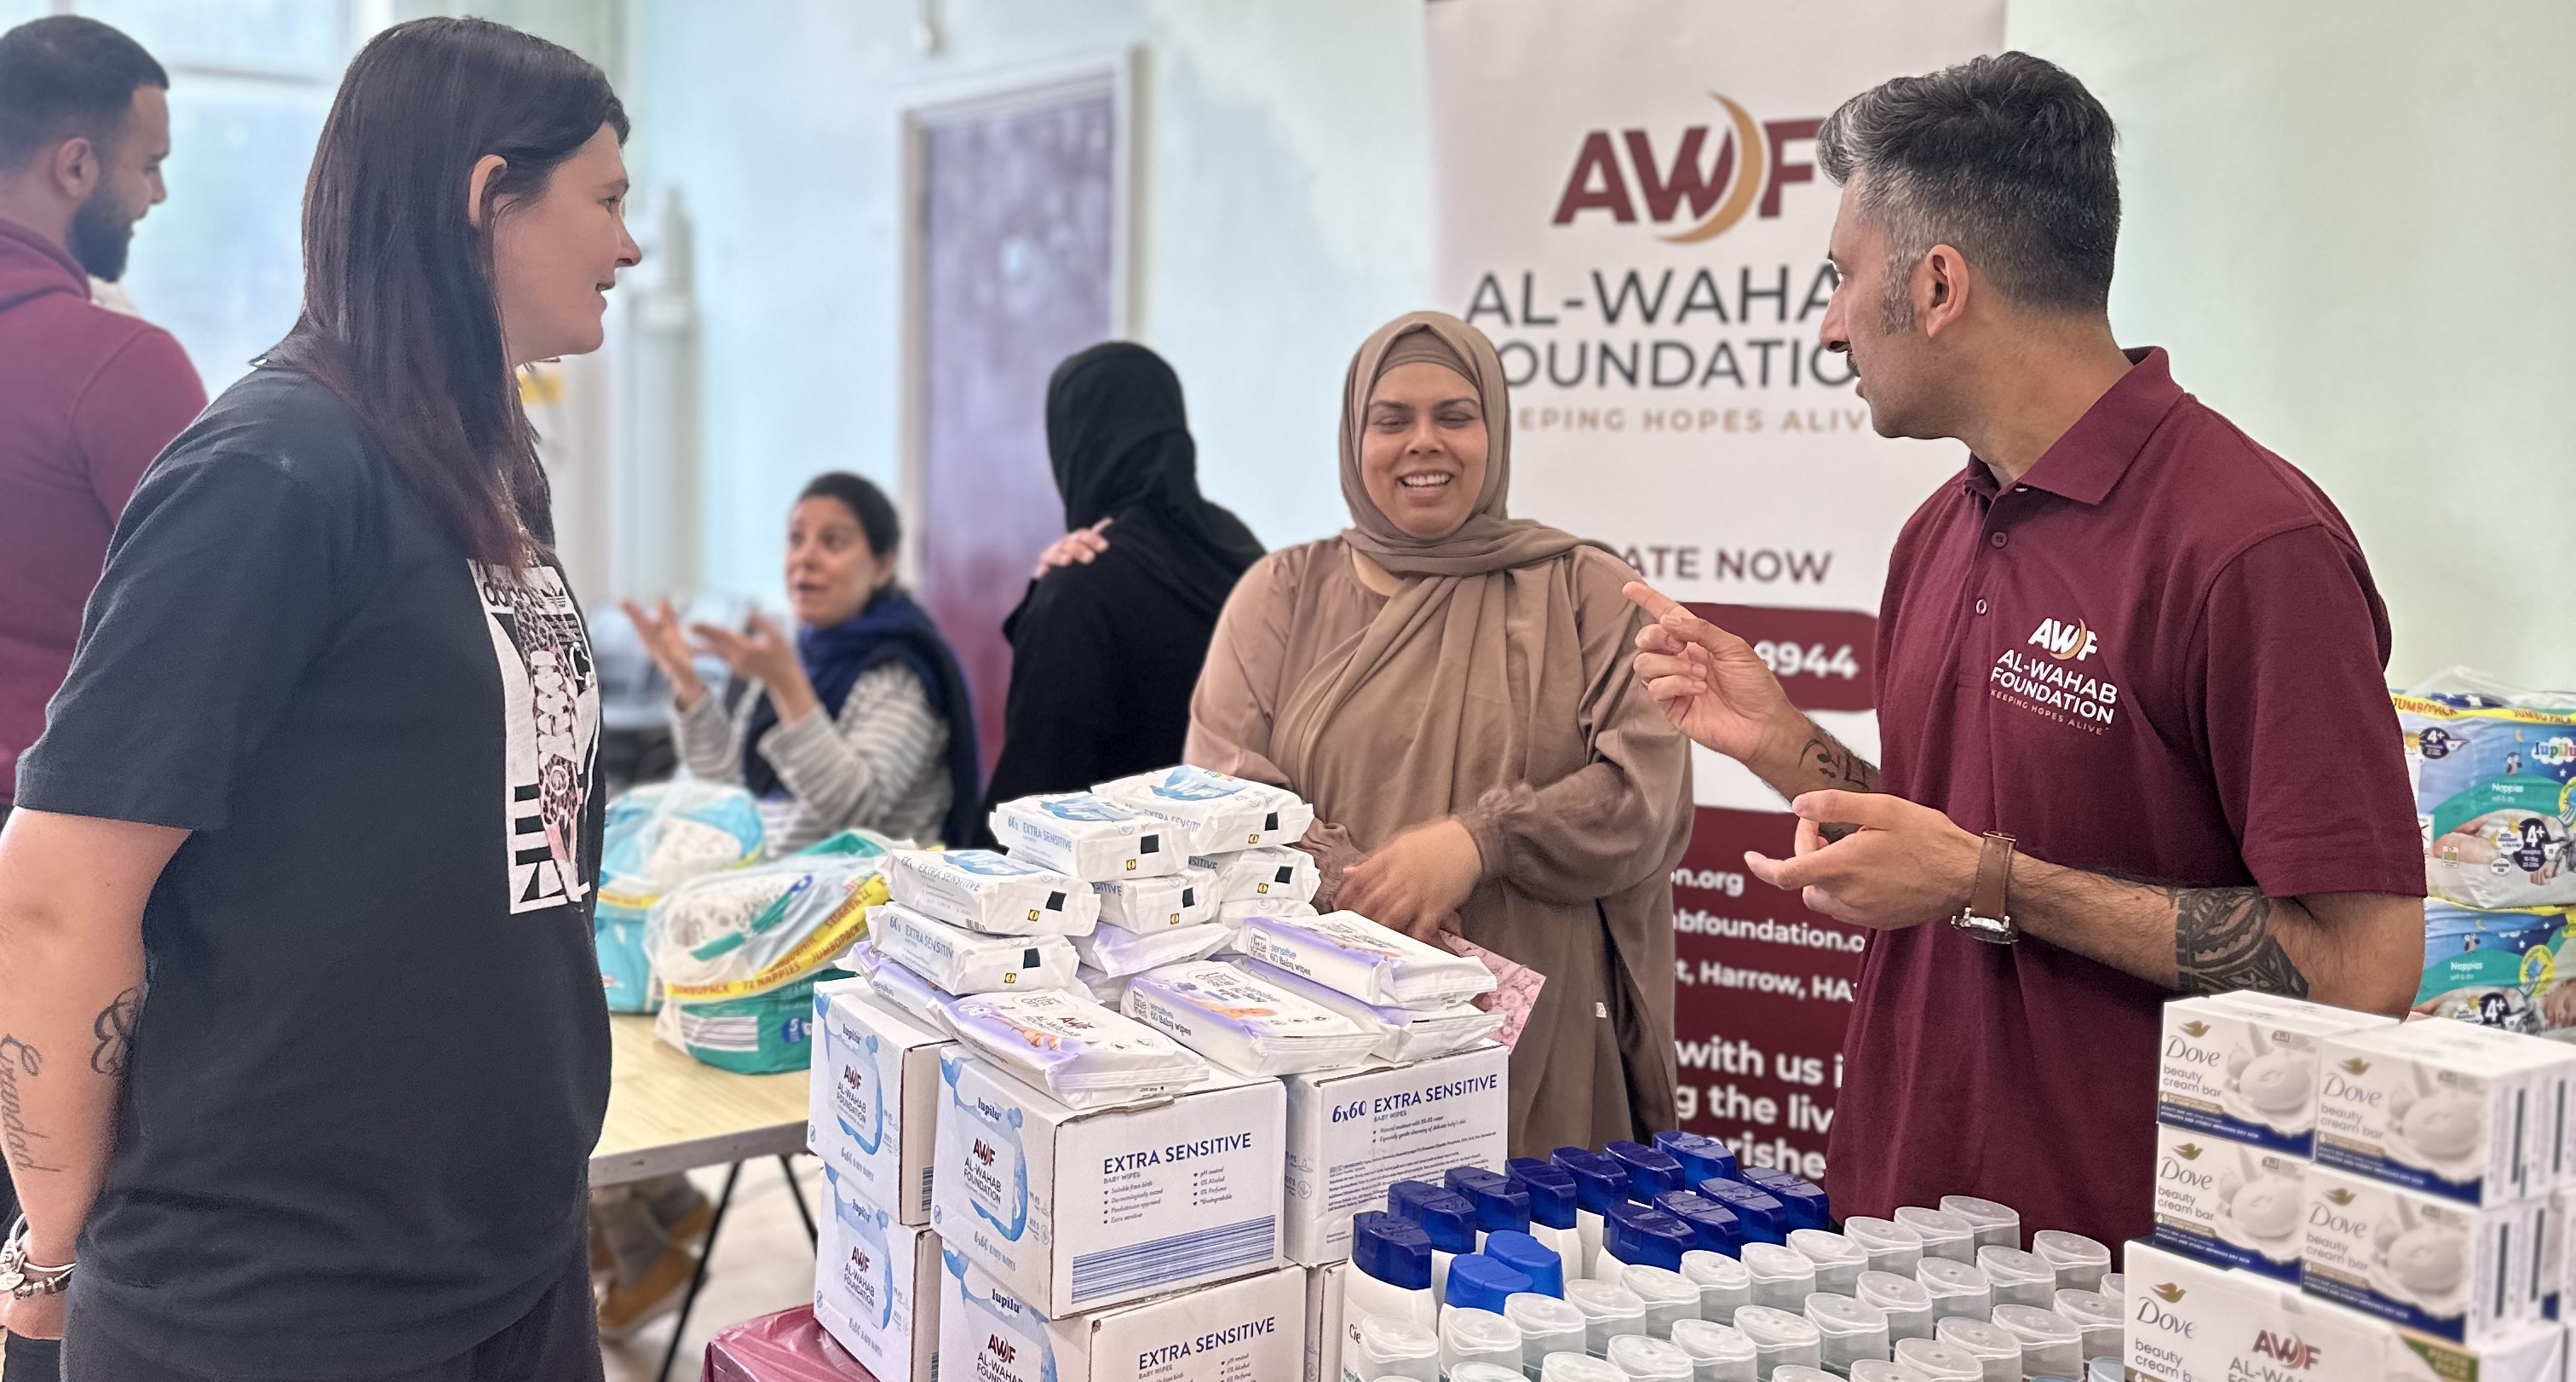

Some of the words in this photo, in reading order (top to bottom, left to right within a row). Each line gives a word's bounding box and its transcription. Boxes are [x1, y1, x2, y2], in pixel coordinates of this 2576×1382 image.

[1550, 106, 1825, 233] AWF
[1465, 266, 1840, 328] AL-WAHA
[1502, 338, 1857, 390] OUNDATIO
[1518, 407, 1625, 432] EPING
[1643, 408, 1763, 433] HOPES
[1780, 408, 1867, 432] ALIV
[1623, 545, 1700, 579] ATE
[1716, 549, 1832, 584] NOW
[2028, 618, 2098, 661] AWF
[1997, 648, 2119, 705] AL-WAHAB
[1990, 666, 2115, 724] FOUNDATION
[1990, 688, 2029, 709] KEEPING
[2031, 705, 2064, 723] HOPES
[2067, 718, 2103, 736] ALIVE
[2534, 741, 2576, 758] lupilu
[1023, 821, 1043, 838] EXTRA
[1044, 830, 1072, 853] SENSITIVE
[2526, 826, 2545, 847] 4+
[1189, 855, 1218, 870] SITIVE
[1094, 881, 1122, 897] SITIVE
[1670, 867, 1745, 898] n.org
[906, 924, 924, 946] EXTRA
[924, 934, 954, 959] SENSITIV
[1675, 907, 1866, 953] bfoundation.o
[757, 962, 801, 986] NAPPIES
[2450, 961, 2483, 971] Nappies
[1700, 960, 1806, 1000] Harrow,
[1812, 976, 1857, 1004] HA
[790, 1018, 799, 1032] 5
[2485, 999, 2506, 1022] 4+
[1676, 1034, 1765, 1077] with
[1775, 1053, 1825, 1087] us
[1834, 1053, 1843, 1088] i
[2165, 1034, 2221, 1067] Dove
[2162, 1076, 2199, 1093] cream
[2202, 1085, 2222, 1098] bar
[2163, 1064, 2203, 1084] beauty
[2323, 1072, 2382, 1107] Dove
[977, 1097, 1000, 1122] lupilu
[1331, 1100, 1367, 1123] 6x60
[1374, 1091, 1422, 1114] EXTRA
[1426, 1074, 1498, 1103] SENSITIVE
[1707, 1085, 1779, 1125] the
[1787, 1093, 1835, 1134] liv
[2320, 1103, 2363, 1124] beauty
[2320, 1115, 2360, 1134] cream
[2362, 1126, 2384, 1140] bar
[973, 1137, 996, 1167] AWF
[1104, 1149, 1161, 1175] EXTRA
[1165, 1132, 1251, 1163] SENSITIVE
[1725, 1131, 1827, 1179] rishe
[963, 1167, 1001, 1206] FOUNDATION
[964, 1156, 1001, 1194] AL-WAHAB
[2159, 1156, 2213, 1190] Dove
[2157, 1197, 2193, 1216] cream
[2195, 1206, 2215, 1222] bar
[2158, 1185, 2196, 1206] beauty
[2309, 1201, 2367, 1238] Dove
[2306, 1231, 2349, 1253] beauty
[852, 1246, 871, 1274] AWF
[2306, 1245, 2344, 1264] cream
[2348, 1256, 2369, 1271] bar
[992, 1288, 1021, 1313] lupilu
[2136, 1296, 2195, 1339] Dove
[988, 1333, 1016, 1364] AWF
[1139, 1341, 1191, 1370] EXTRA
[1196, 1316, 1275, 1353] SENSITIVE
[1348, 1323, 1361, 1344] Cie
[2252, 1327, 2321, 1370] AWF
[2135, 1338, 2183, 1368] beauty
[2135, 1354, 2179, 1379] cream
